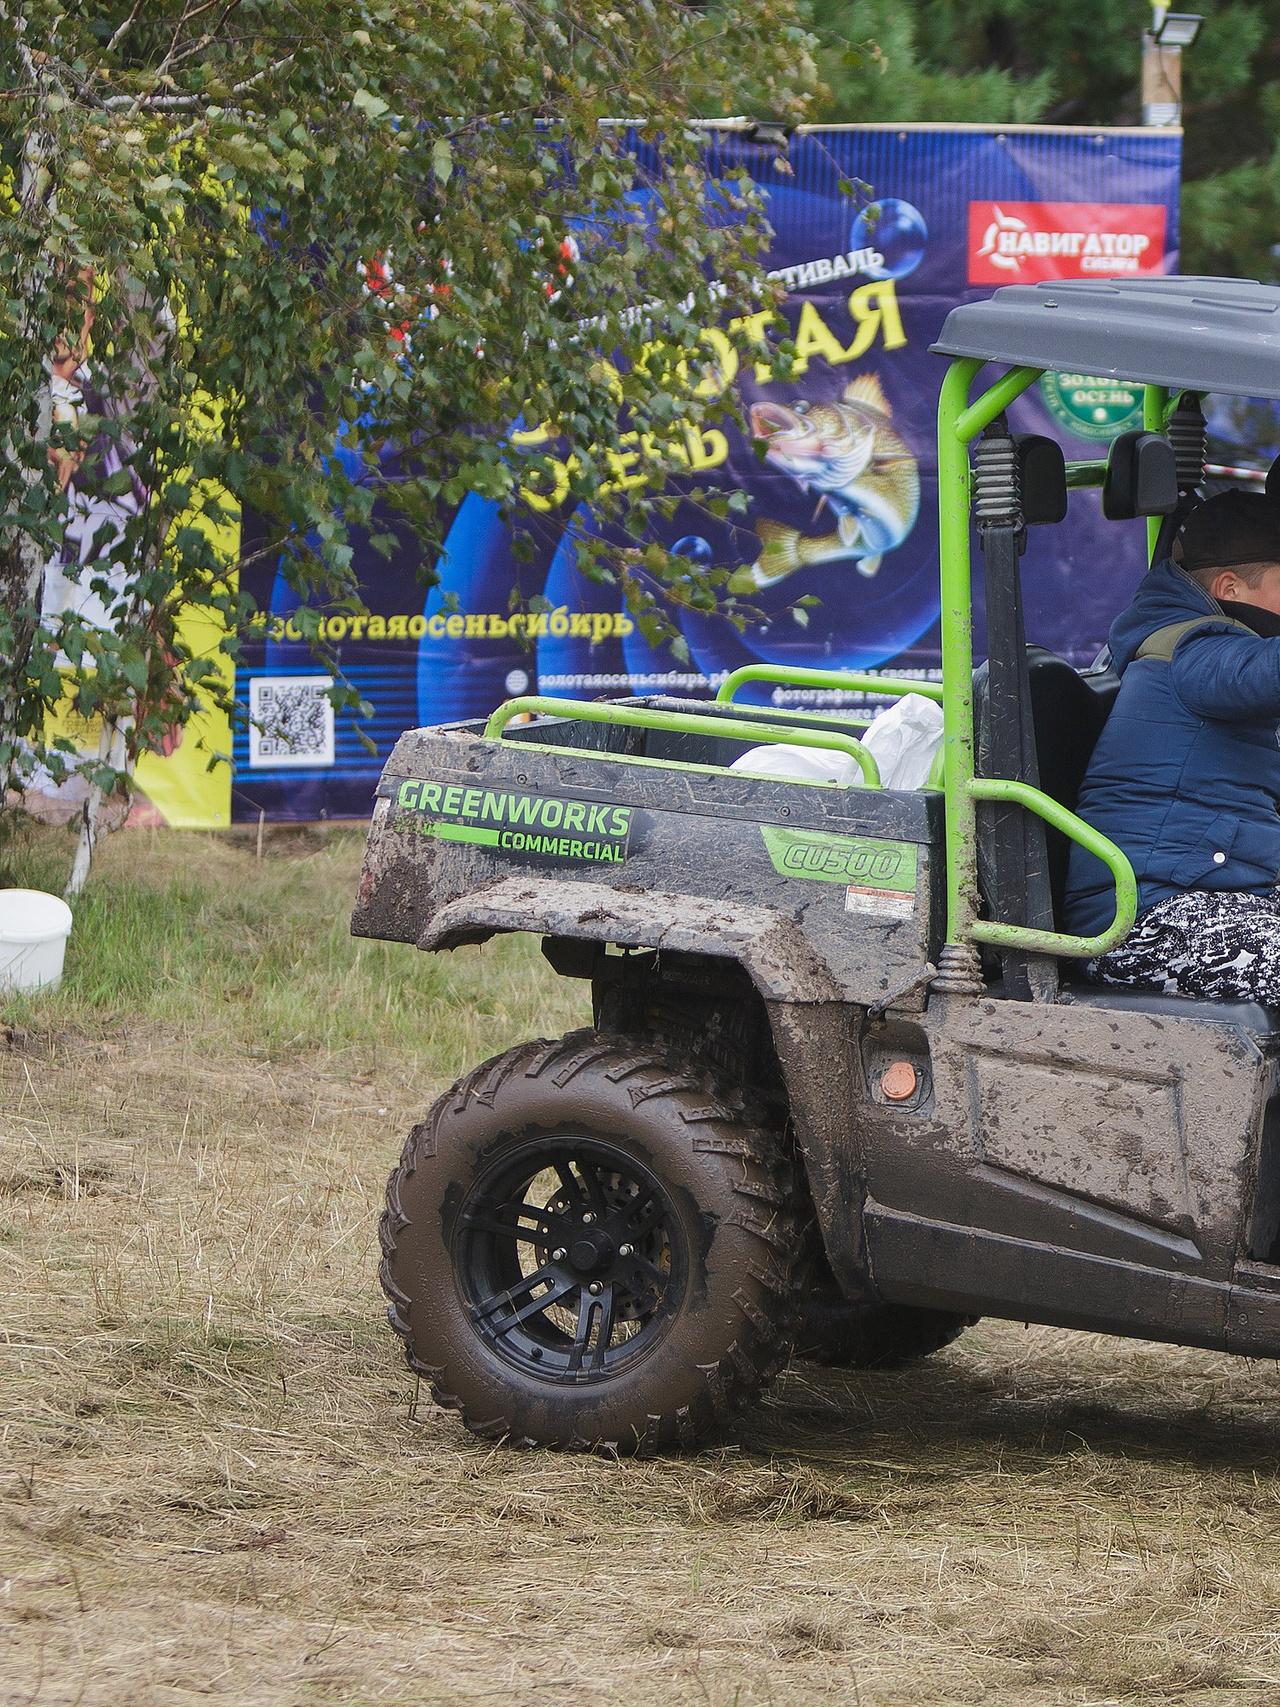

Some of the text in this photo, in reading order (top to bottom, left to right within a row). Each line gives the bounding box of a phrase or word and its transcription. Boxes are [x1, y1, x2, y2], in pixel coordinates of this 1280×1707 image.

[998, 231, 1150, 257] НАВИГАТОР
[1081, 256, 1140, 272] СИБИРИ
[1071, 389, 1136, 406] ОСЕНЬ
[397, 779, 632, 837] GREENWORKS
[501, 830, 626, 863] COMMERCIAL
[783, 842, 903, 881] CU500
